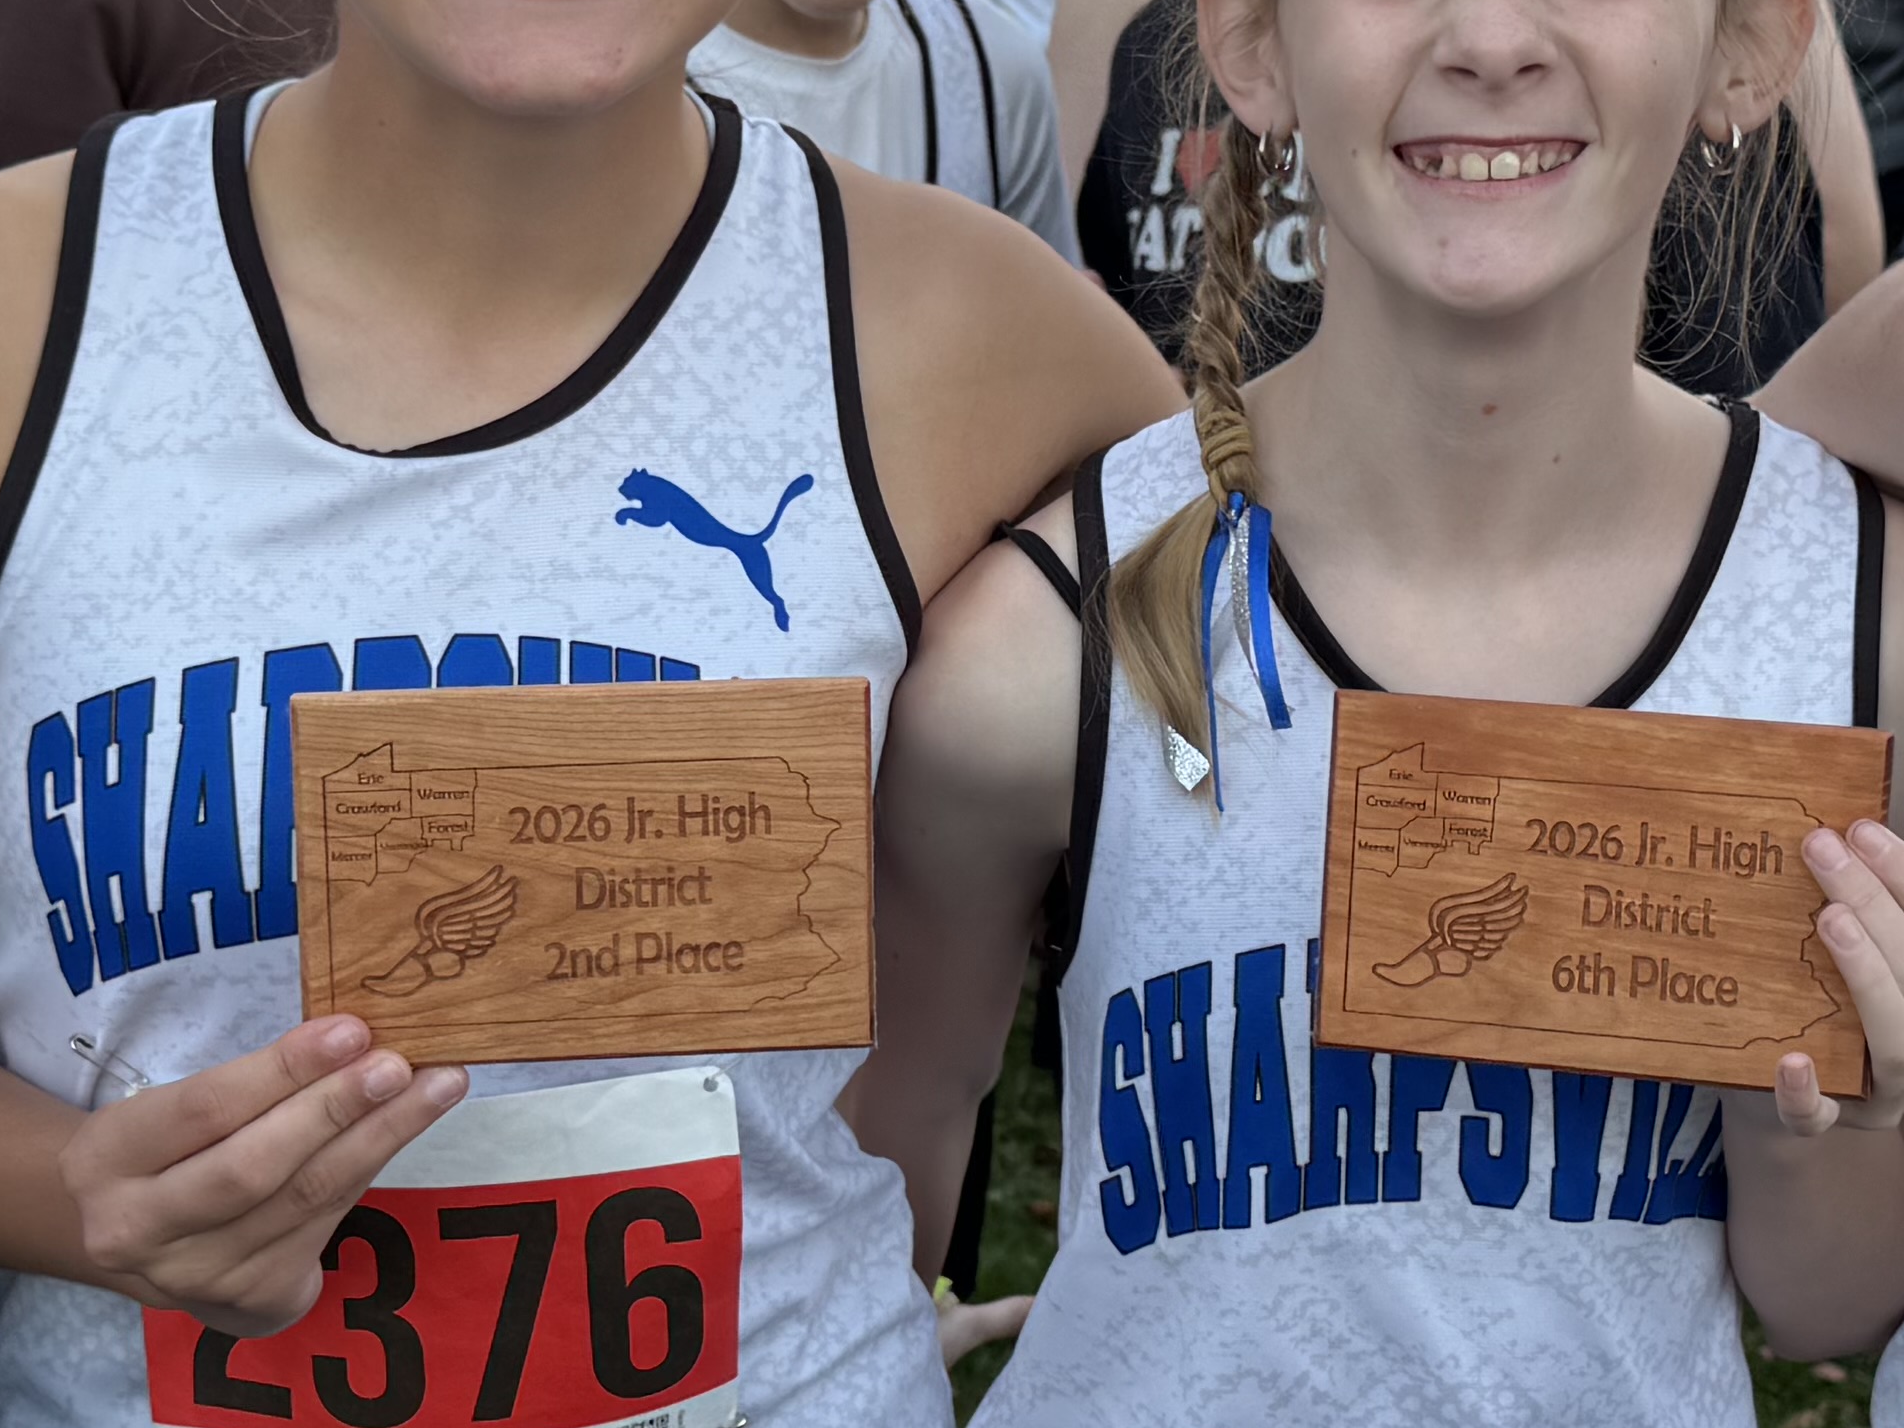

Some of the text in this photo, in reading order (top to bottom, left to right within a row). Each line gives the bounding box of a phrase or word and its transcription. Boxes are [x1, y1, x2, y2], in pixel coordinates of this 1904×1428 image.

[508, 791, 772, 844] 2026 Jr. High
[1525, 818, 1784, 878] 2026 Jr. High
[575, 866, 713, 911] District
[1581, 884, 1718, 938] District
[545, 932, 745, 980] 2nd Place
[1552, 953, 1739, 1006] 6th Place
